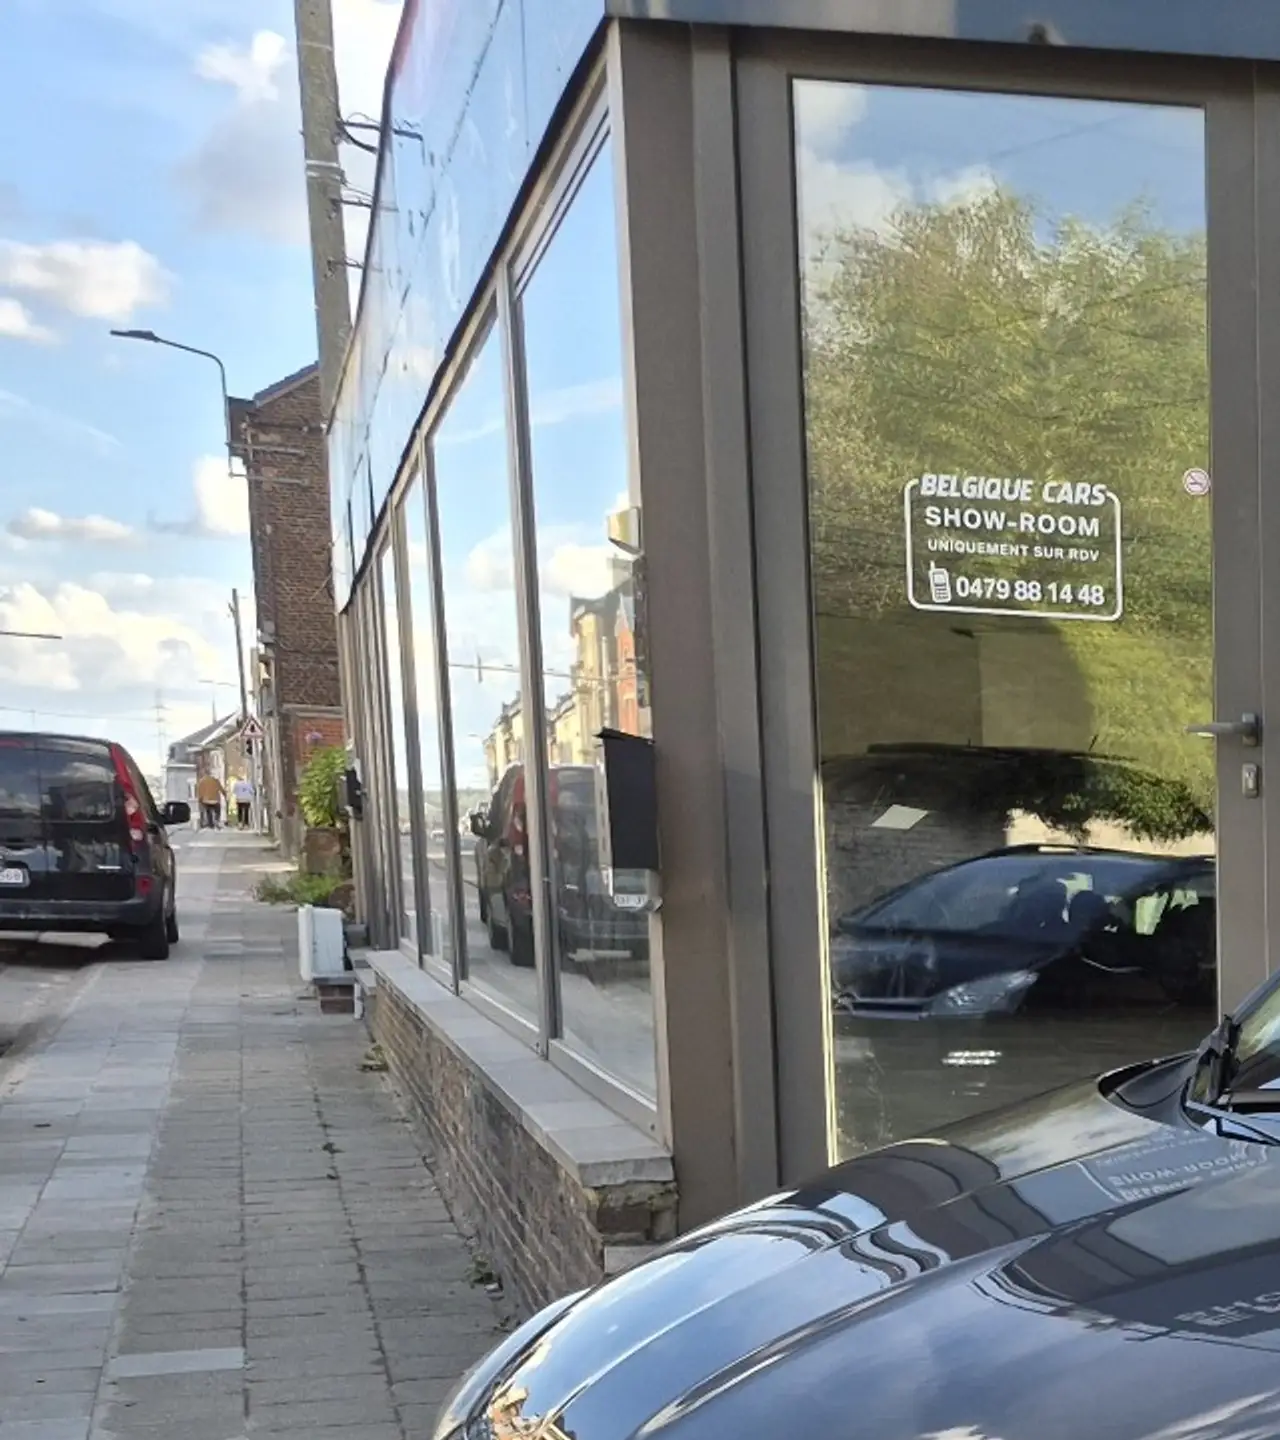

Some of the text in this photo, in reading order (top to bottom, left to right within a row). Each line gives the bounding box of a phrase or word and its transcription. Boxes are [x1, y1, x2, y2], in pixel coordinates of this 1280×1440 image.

[920, 474, 1108, 507] BELGIQUE CARS
[925, 506, 1100, 537] SHOW-ROOM
[928, 539, 1100, 562] UNIQUEMENT SUR RDV
[956, 576, 1105, 606] 0479 88 14 48
